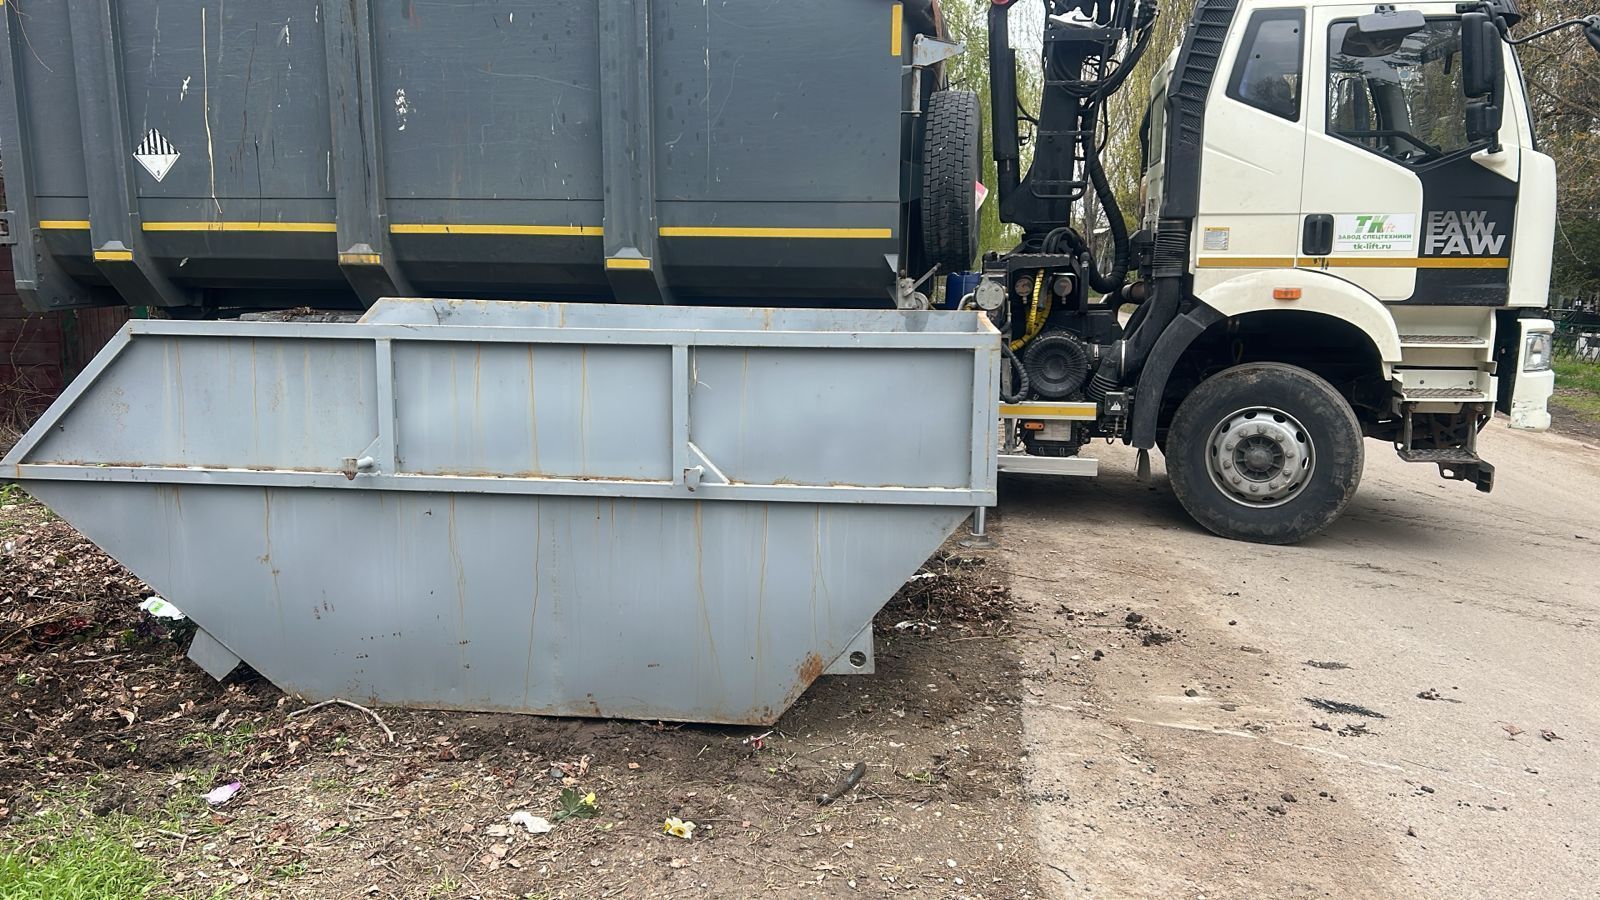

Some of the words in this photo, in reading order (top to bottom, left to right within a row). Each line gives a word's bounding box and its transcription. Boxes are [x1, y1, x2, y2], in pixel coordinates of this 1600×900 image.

[1427, 211, 1487, 225] FAW
[1426, 222, 1496, 238] FAW
[1424, 235, 1506, 254] FAW
